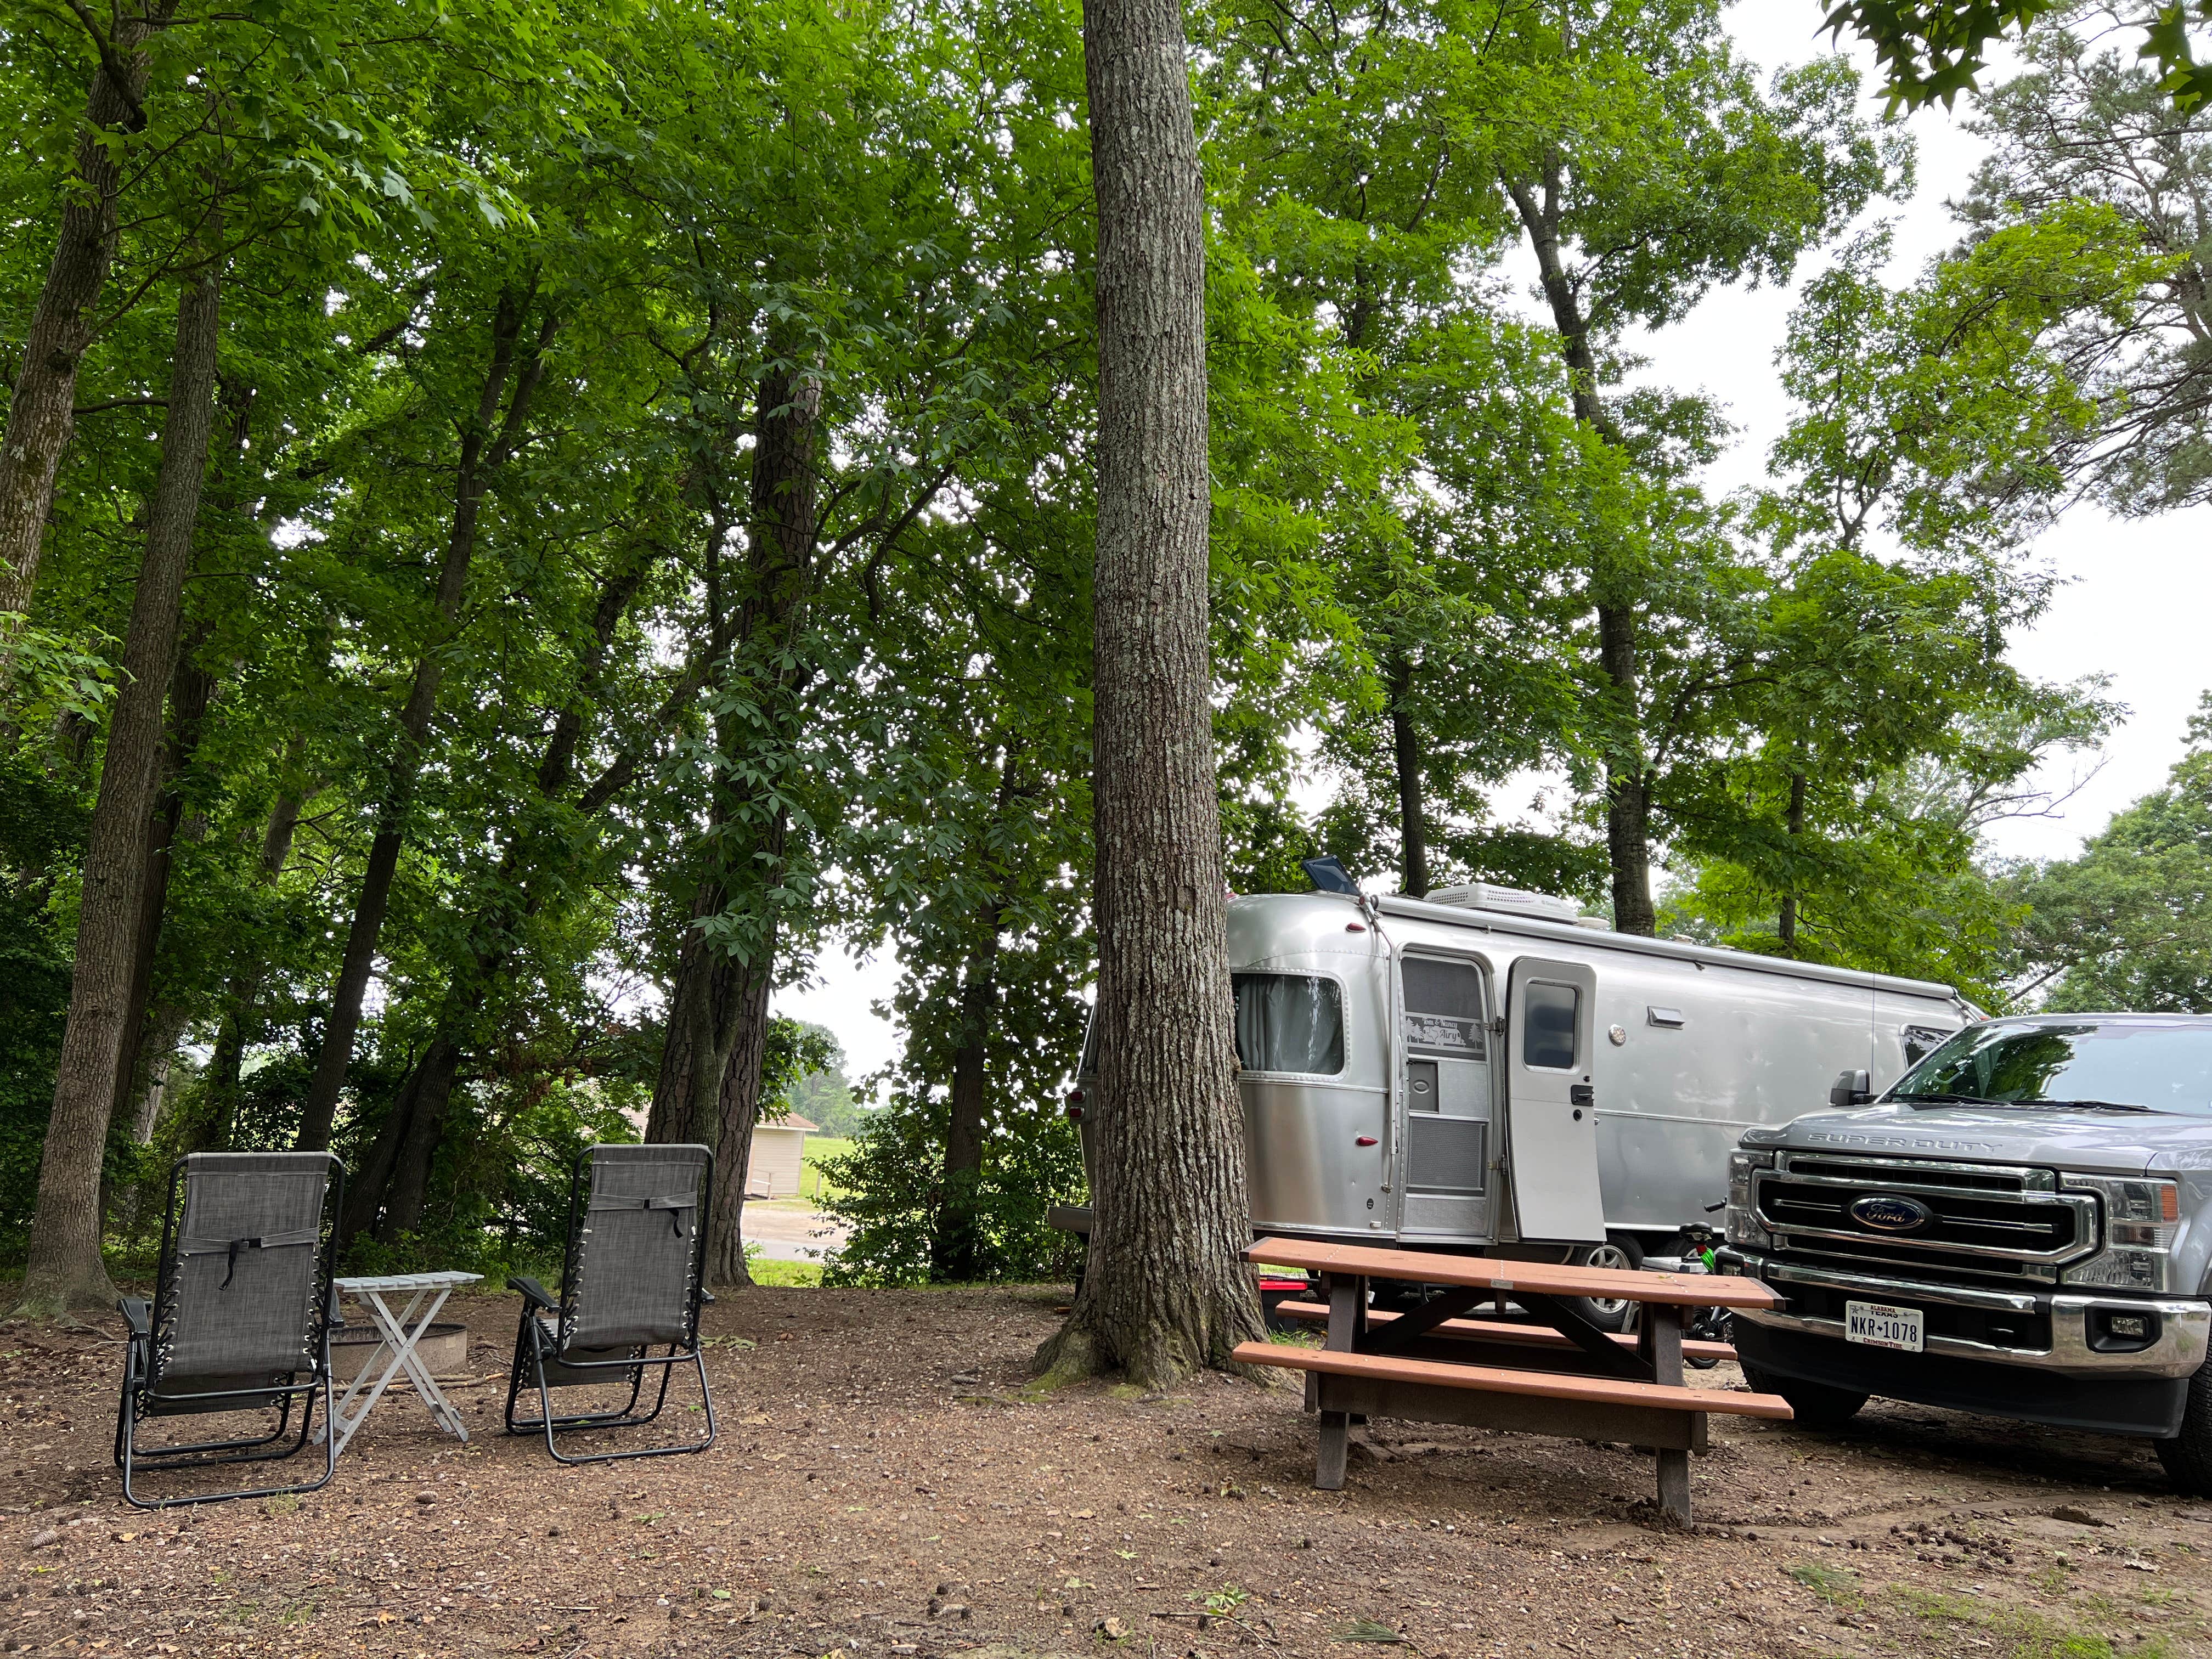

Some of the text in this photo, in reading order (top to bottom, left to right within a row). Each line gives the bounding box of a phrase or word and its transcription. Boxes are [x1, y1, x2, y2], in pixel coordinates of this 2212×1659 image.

[1440, 1029, 1457, 1042] Airy
[1808, 1133, 2002, 1152] SUPER DUTY
[1866, 1204, 1906, 1222] Ford
[1870, 1305, 1897, 1313] ALABAMA
